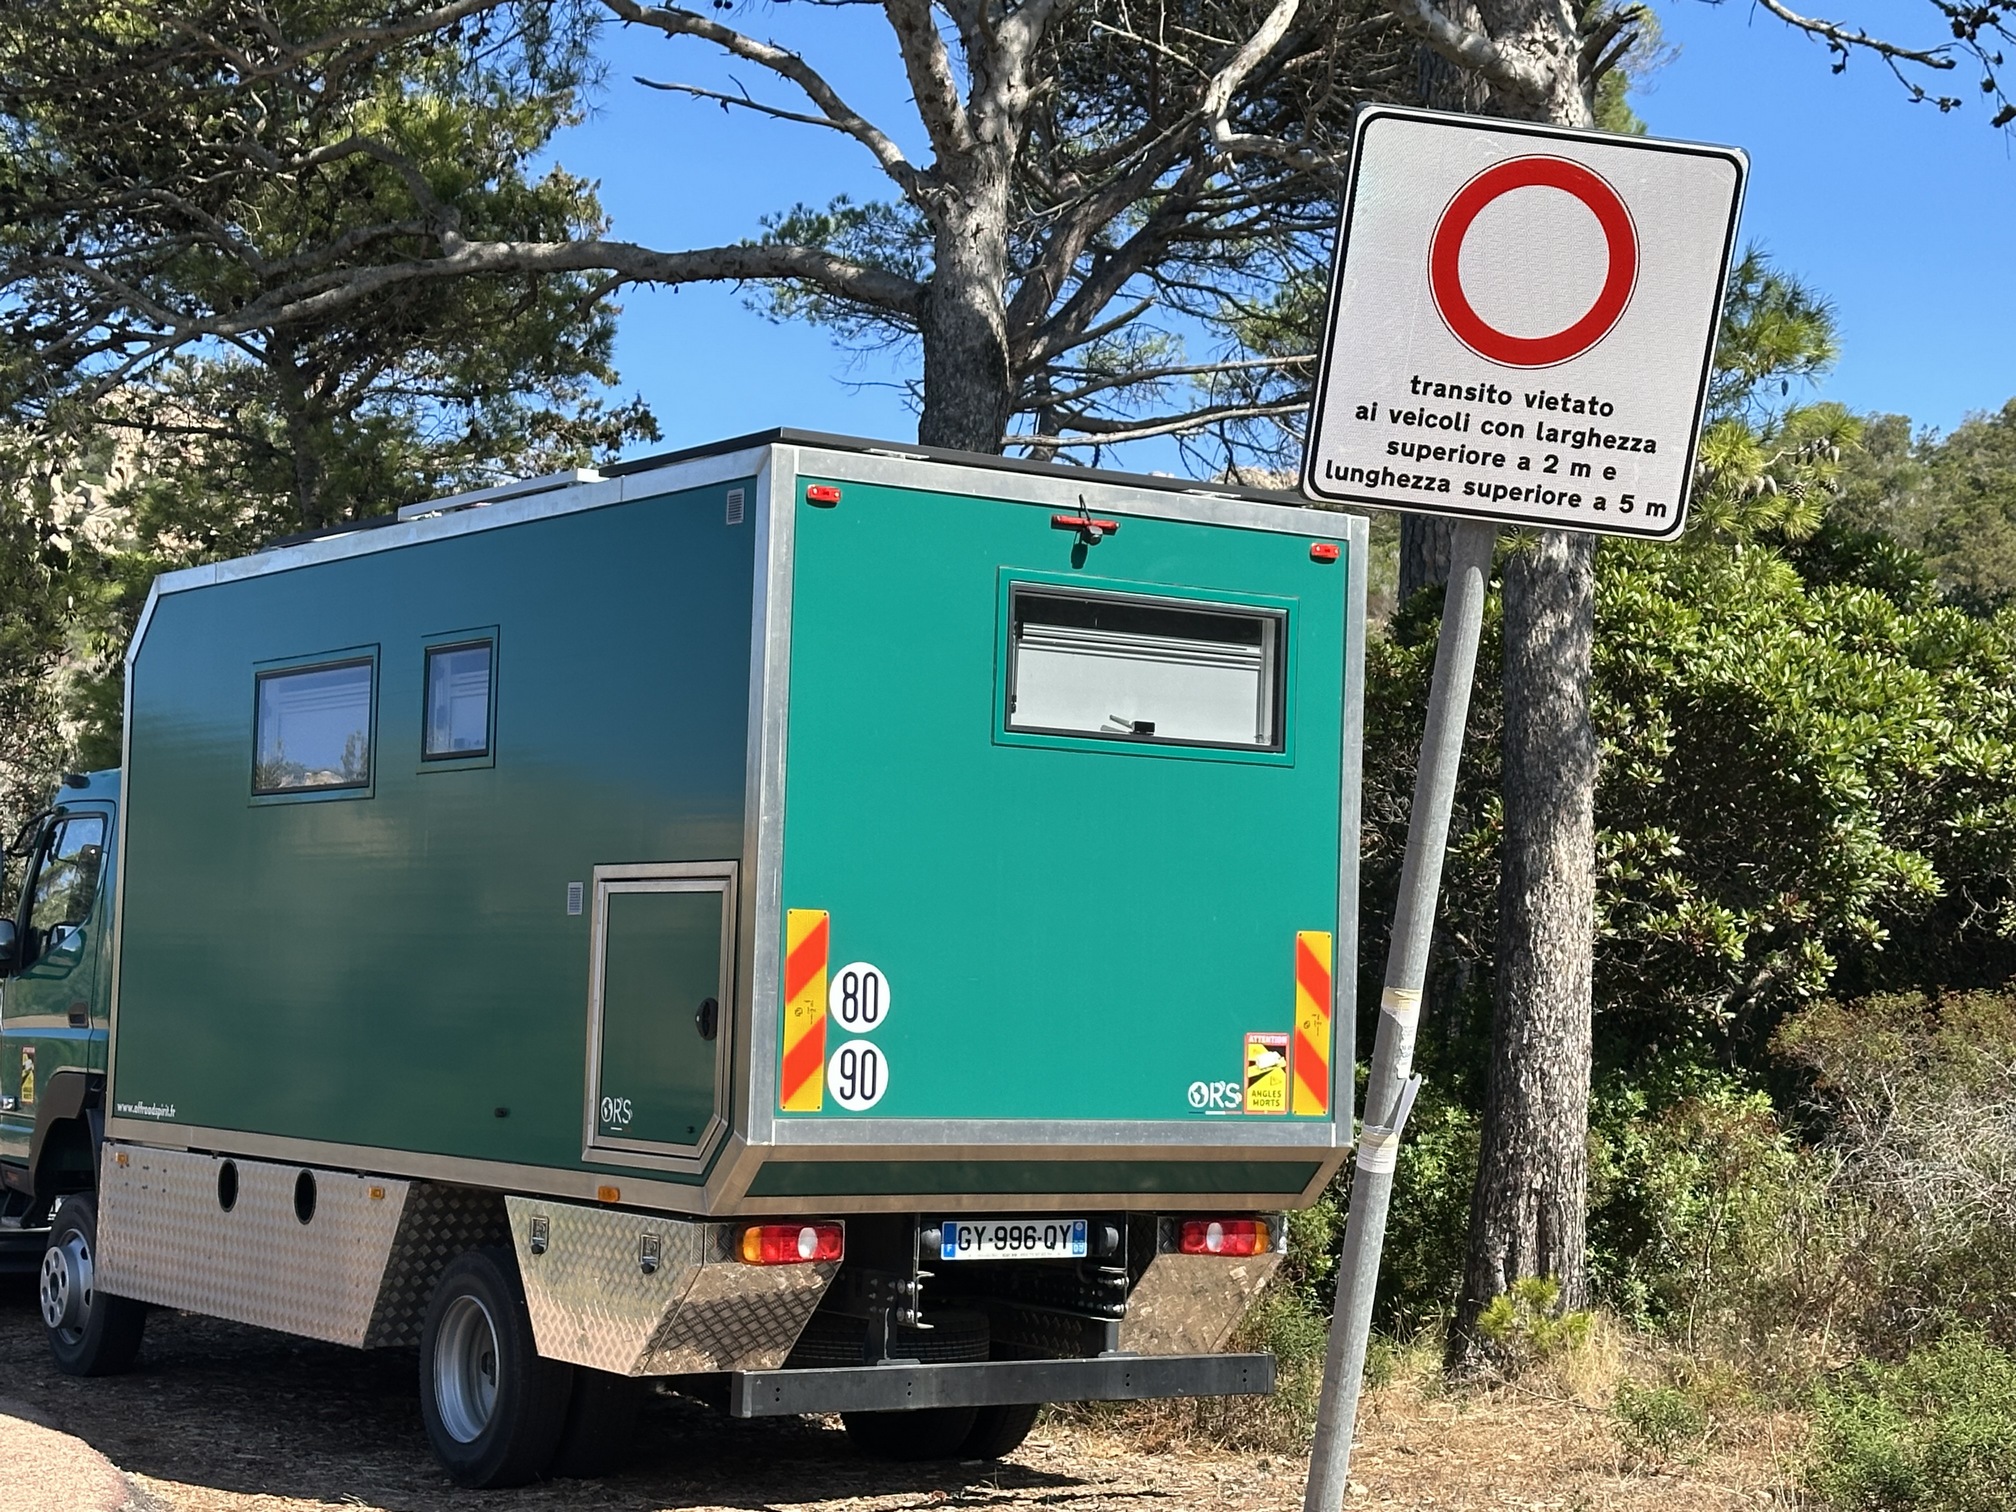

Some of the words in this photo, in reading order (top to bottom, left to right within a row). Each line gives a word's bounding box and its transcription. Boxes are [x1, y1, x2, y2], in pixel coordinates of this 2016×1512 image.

[1410, 374, 1513, 406] transito
[1524, 389, 1615, 418] vietato
[1355, 402, 1378, 422] ai
[1389, 406, 1471, 433] veicoli
[1480, 420, 1525, 440] con
[1536, 422, 1658, 455] larghezza
[1386, 438, 1506, 467] superiore
[1516, 456, 1531, 472] a
[1542, 454, 1560, 475] 2
[1569, 461, 1592, 479] m
[1602, 466, 1618, 481] e
[1325, 460, 1451, 493] lunghezza
[1462, 480, 1582, 509] superiore
[1592, 496, 1608, 512] a
[1618, 493, 1635, 515] 5
[1645, 502, 1668, 518] m
[842, 971, 879, 1023] 80
[839, 1048, 877, 1101] 90
[1251, 1089, 1282, 1098] ANGLES
[1252, 1099, 1281, 1107] MORTS
[958, 1225, 1071, 1250] GY-996-QY
